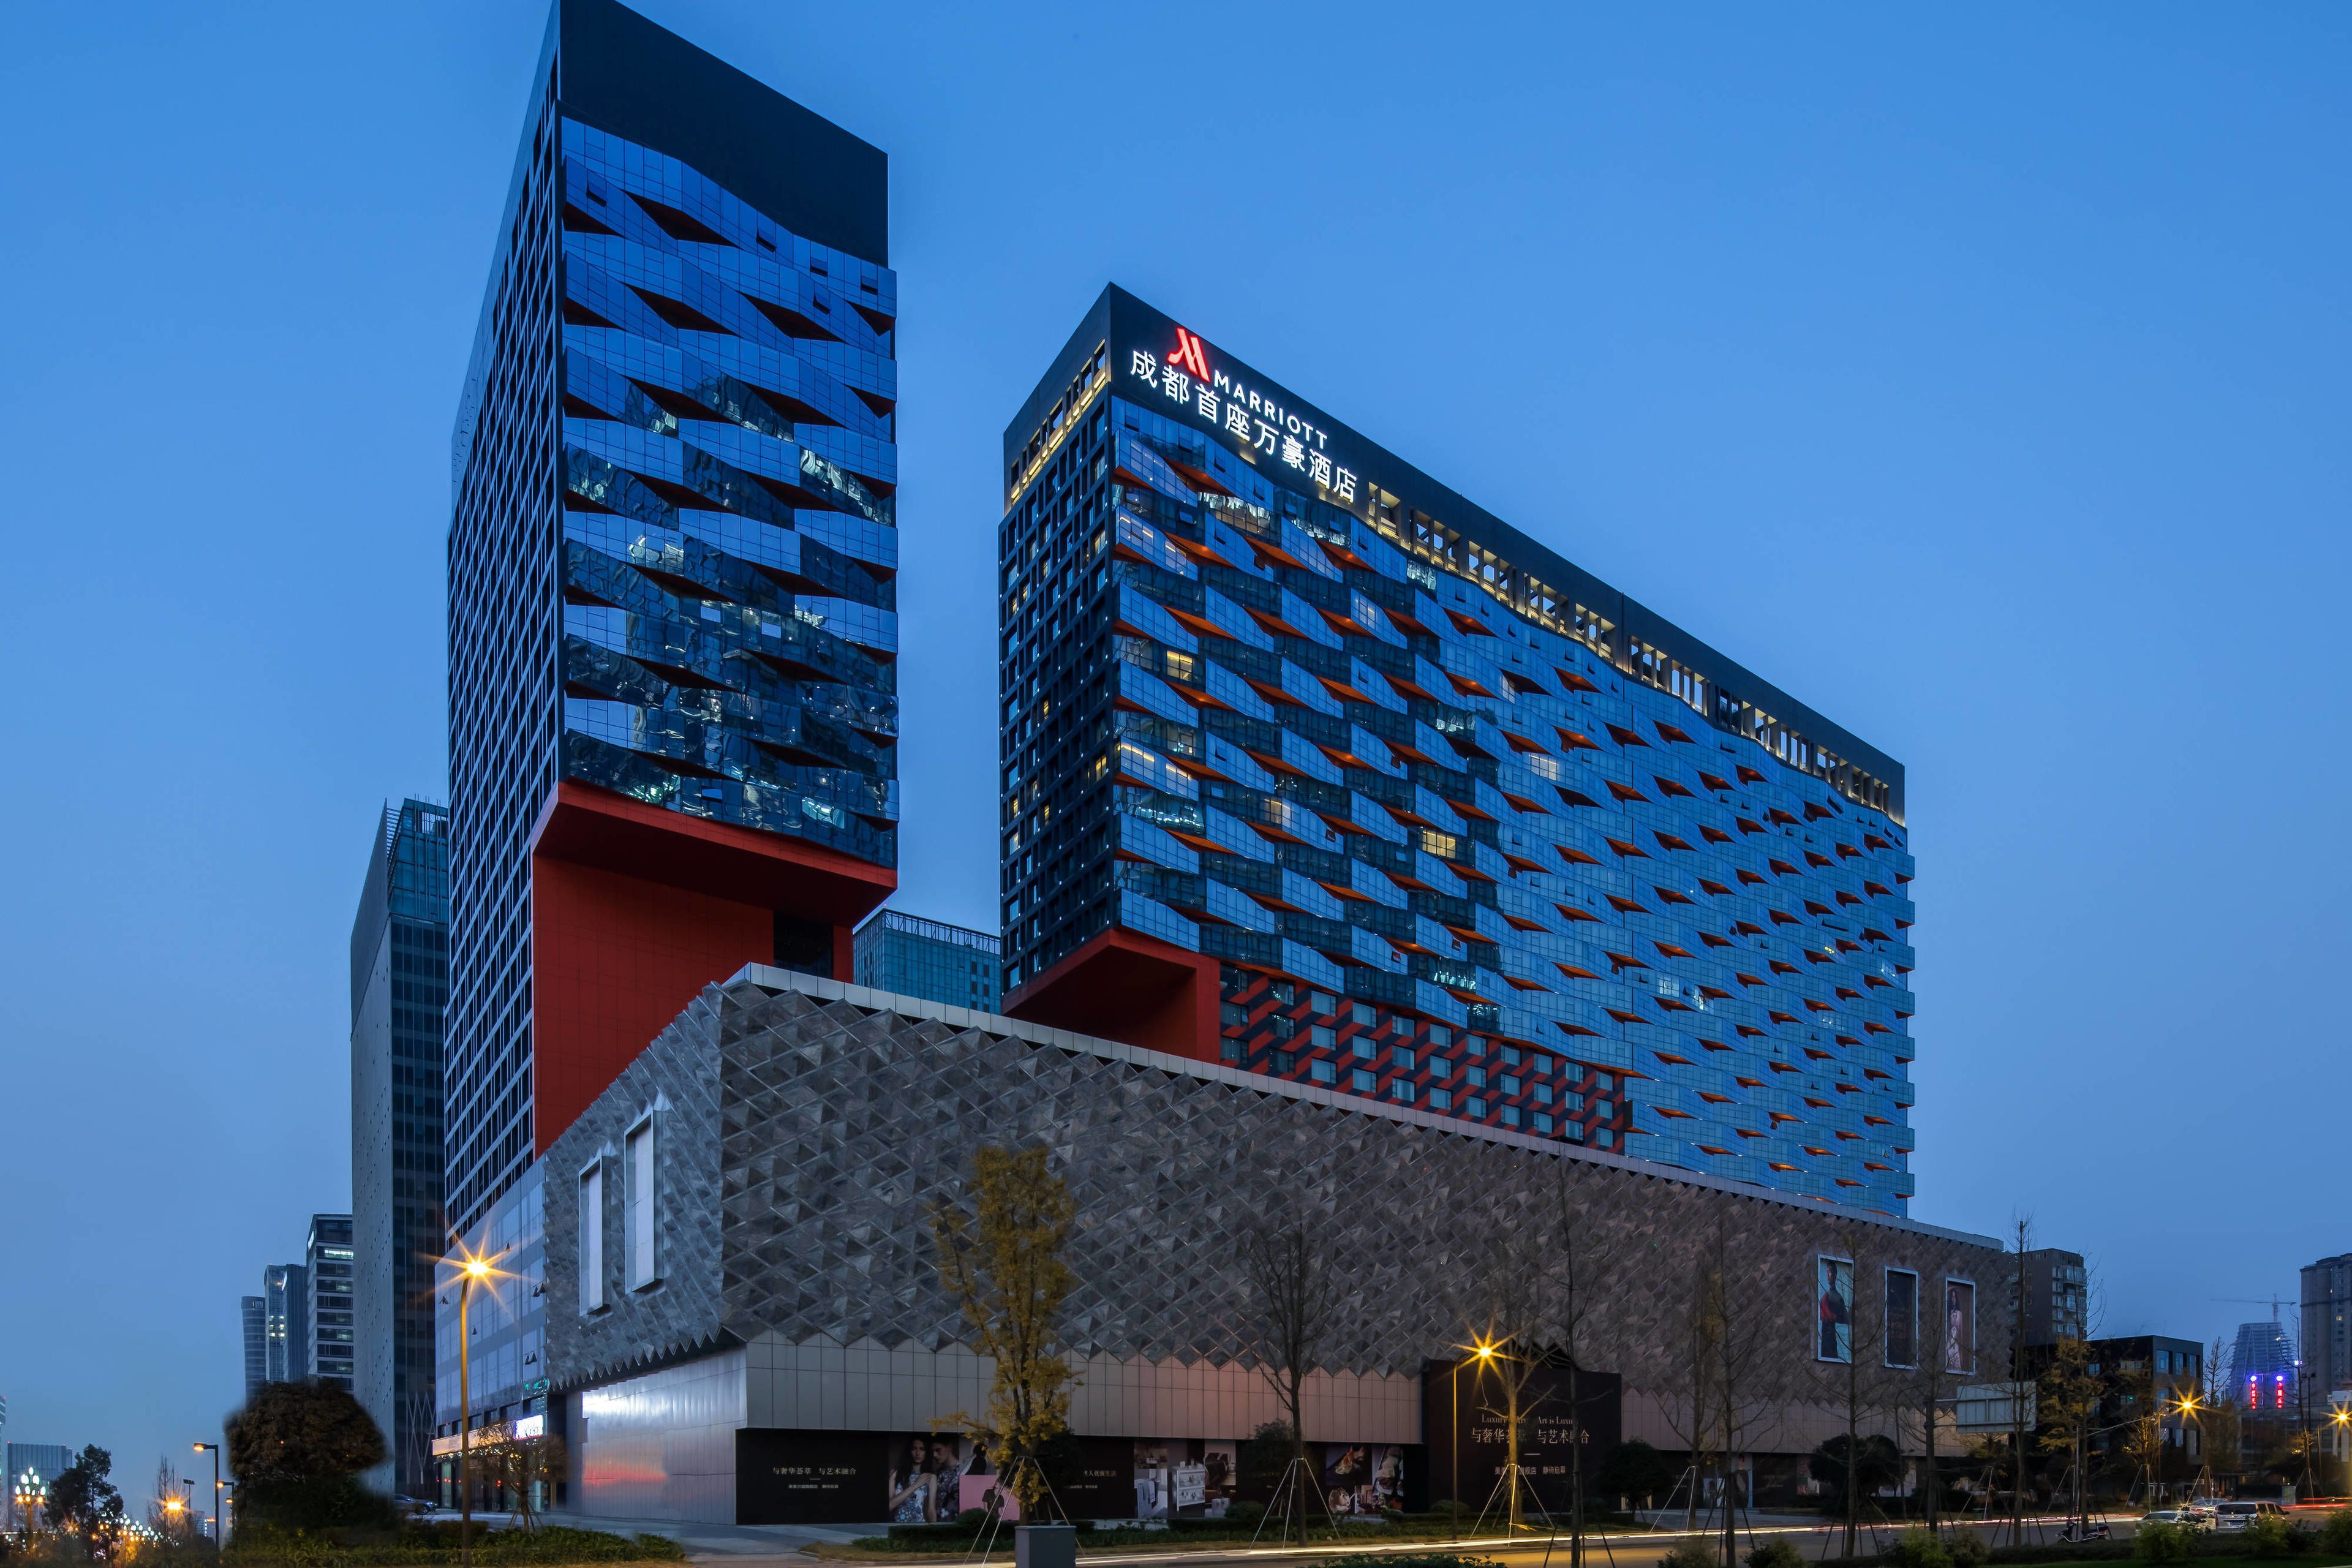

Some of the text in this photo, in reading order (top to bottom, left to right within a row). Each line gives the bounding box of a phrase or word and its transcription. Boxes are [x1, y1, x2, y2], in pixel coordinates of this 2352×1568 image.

[1131, 350, 1357, 503] 成都首座万豪酒店
[1215, 370, 1328, 449] MARRIOTT
